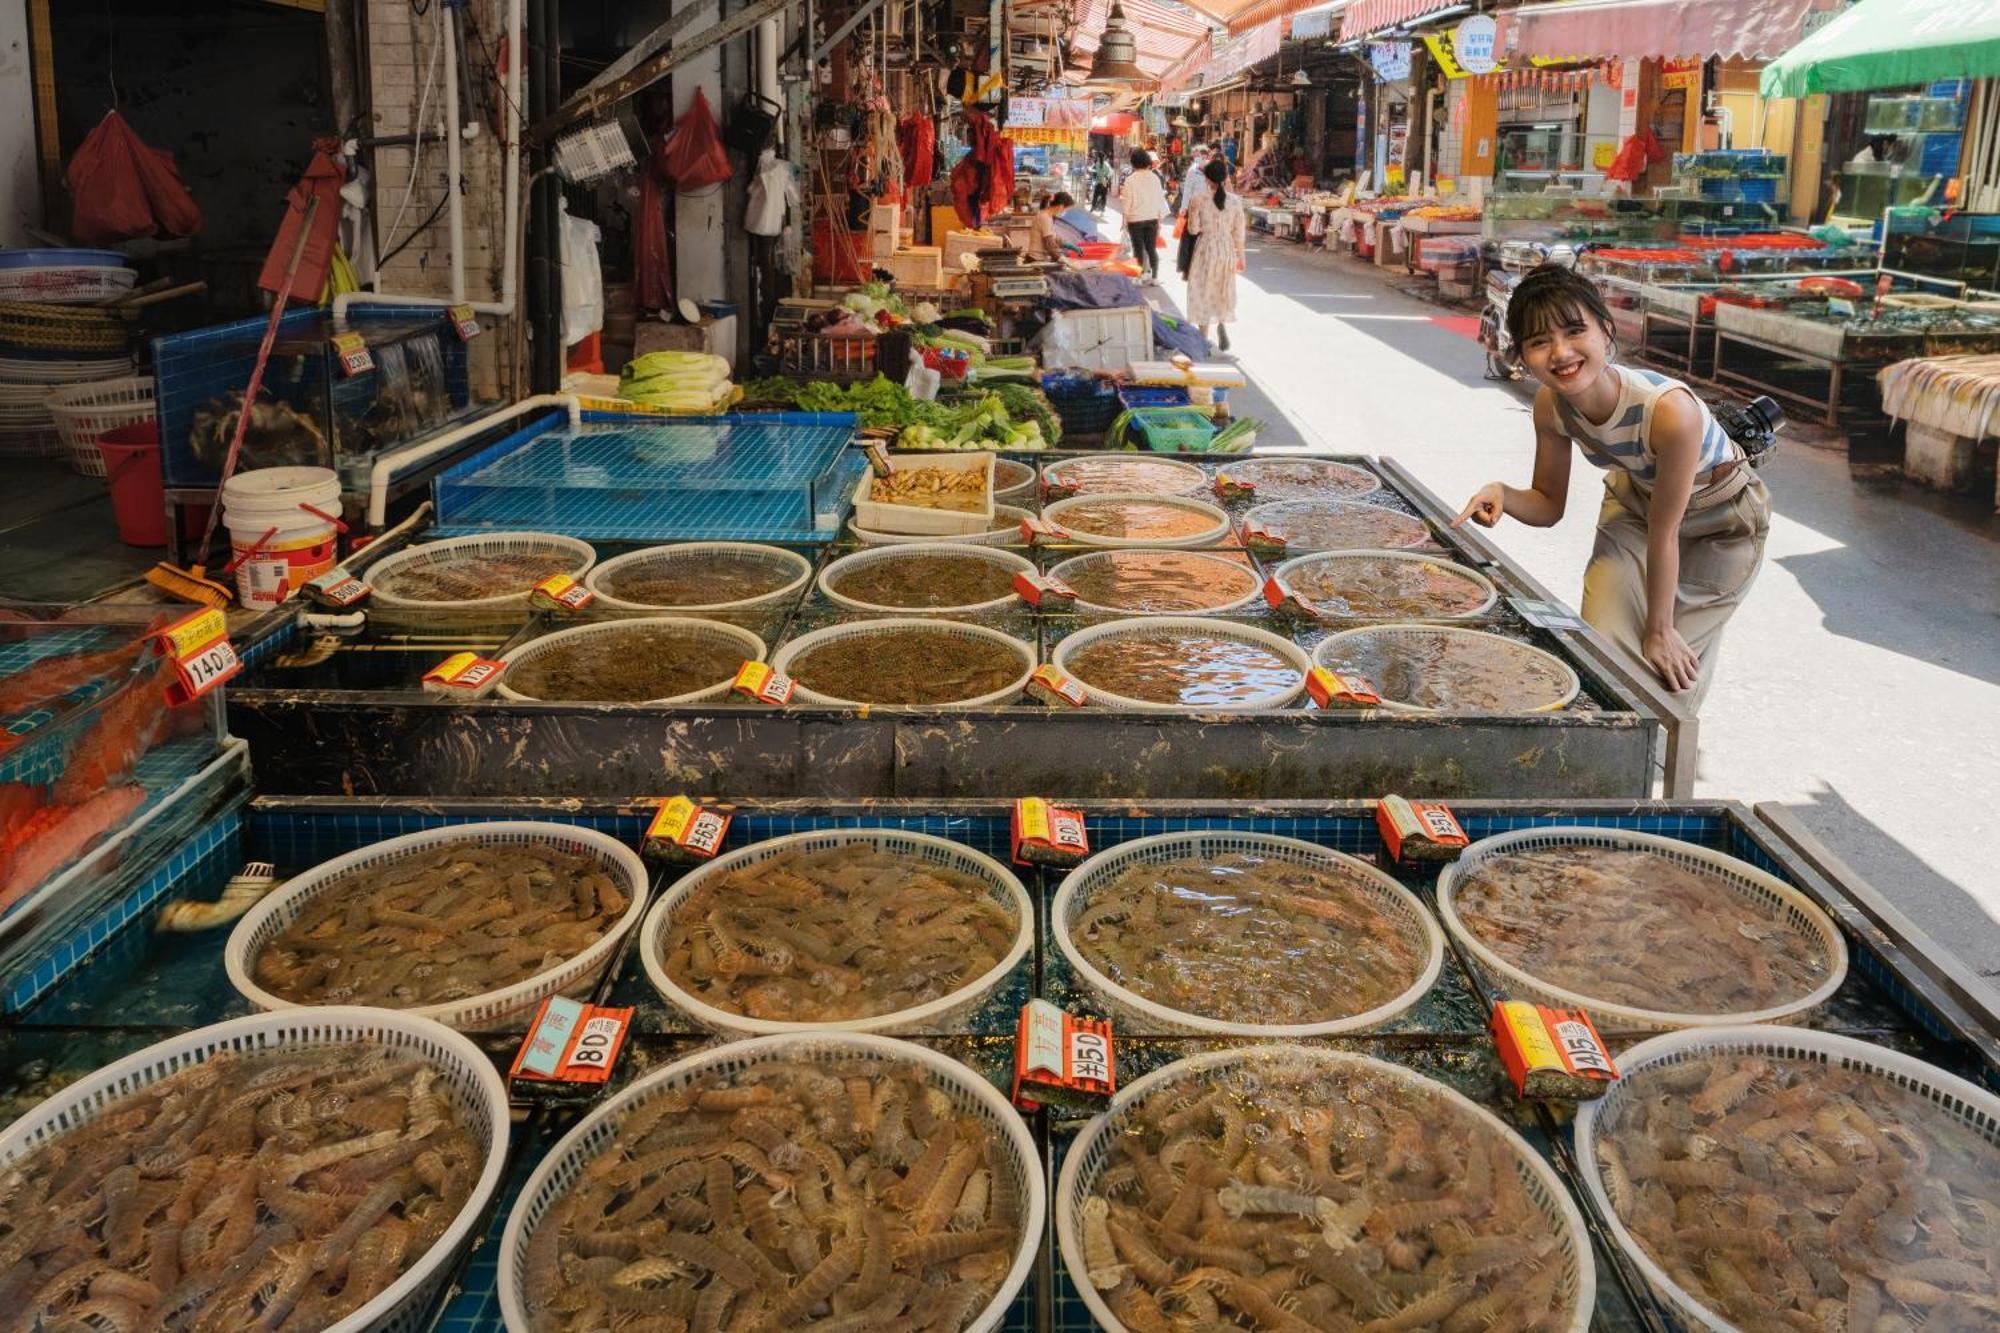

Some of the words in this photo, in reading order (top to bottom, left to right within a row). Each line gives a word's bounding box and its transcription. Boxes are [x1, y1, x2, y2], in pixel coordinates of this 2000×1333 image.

[192, 652, 223, 683] 140
[576, 1034, 608, 1061] 80
[1076, 1034, 1104, 1077] ¥50
